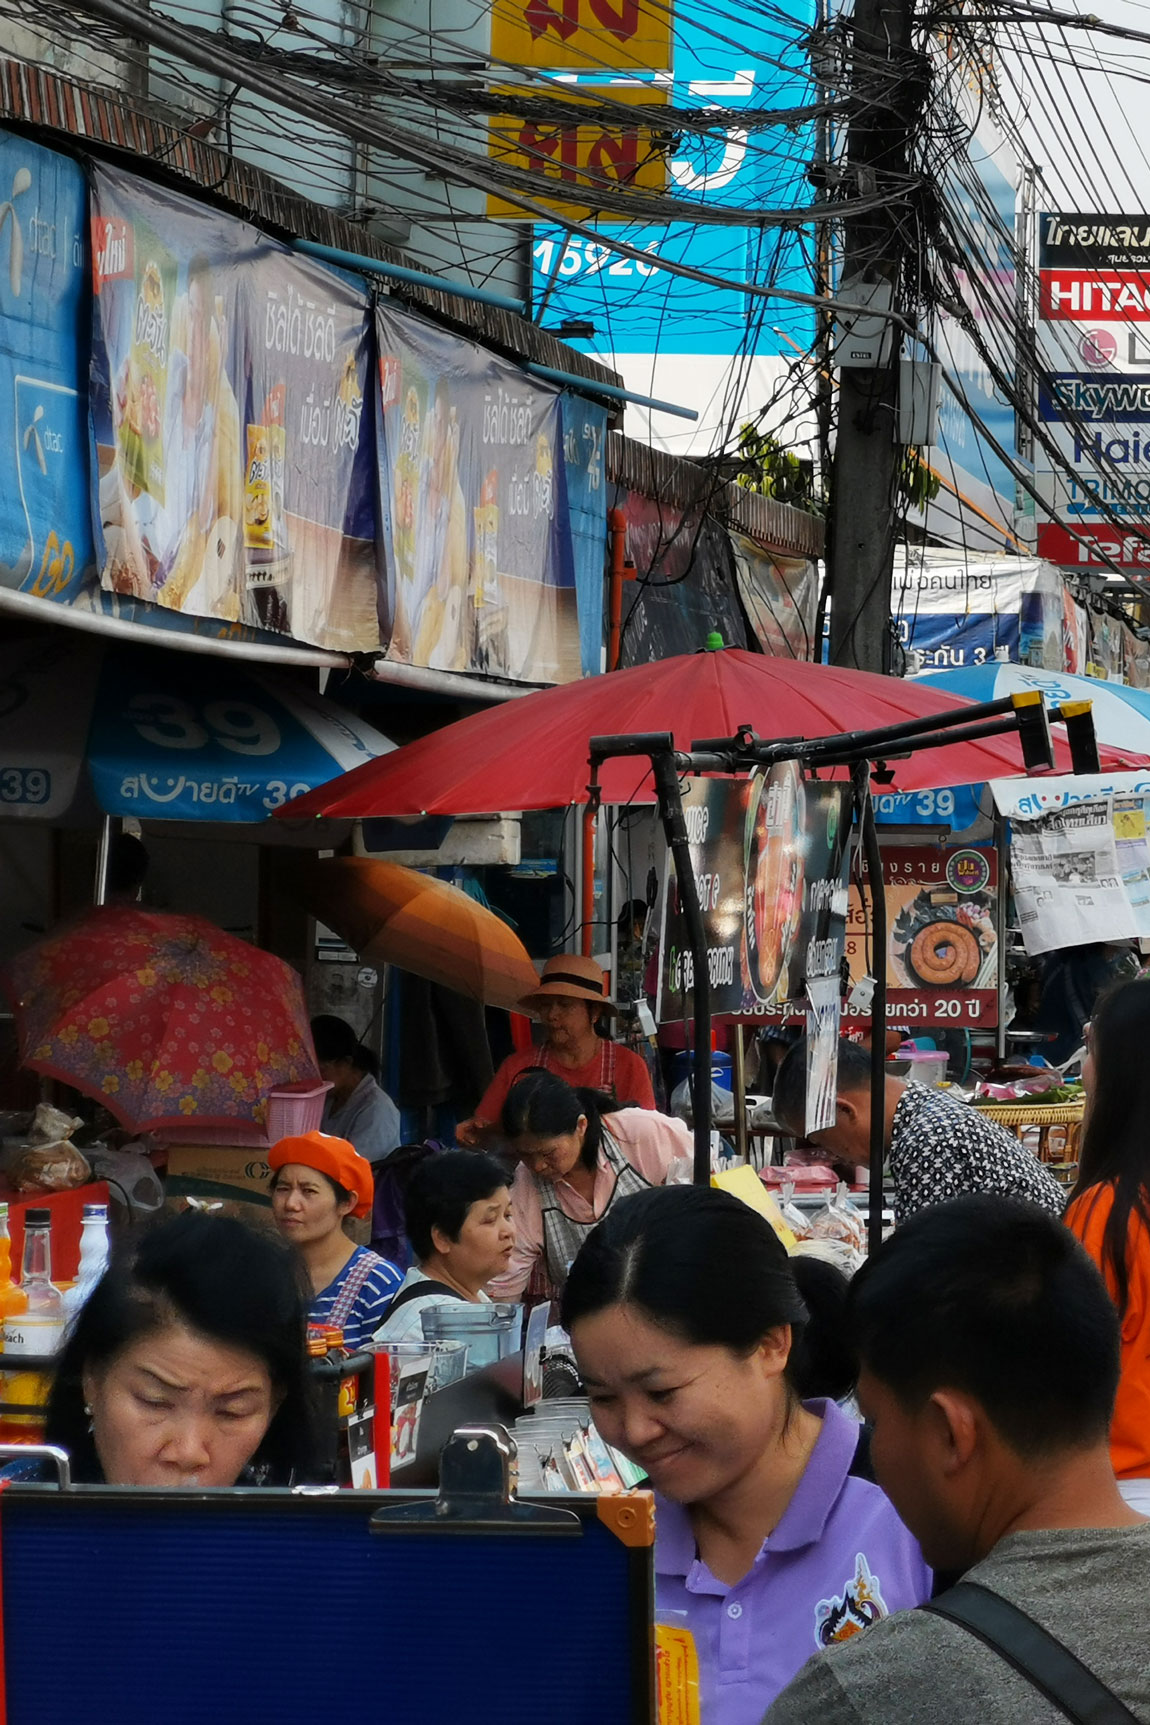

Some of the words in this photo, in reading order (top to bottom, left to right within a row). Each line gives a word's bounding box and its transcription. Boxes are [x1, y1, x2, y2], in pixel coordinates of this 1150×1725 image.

[29, 206, 56, 259] dtac
[44, 425, 63, 453] dtac
[973, 647, 986, 666] 3
[131, 693, 281, 757] 39
[1, 769, 48, 800] 39
[916, 789, 955, 816] 39
[934, 1000, 961, 1018] 20
[964, 999, 980, 1018] ปี
[5, 1332, 24, 1344] ach
